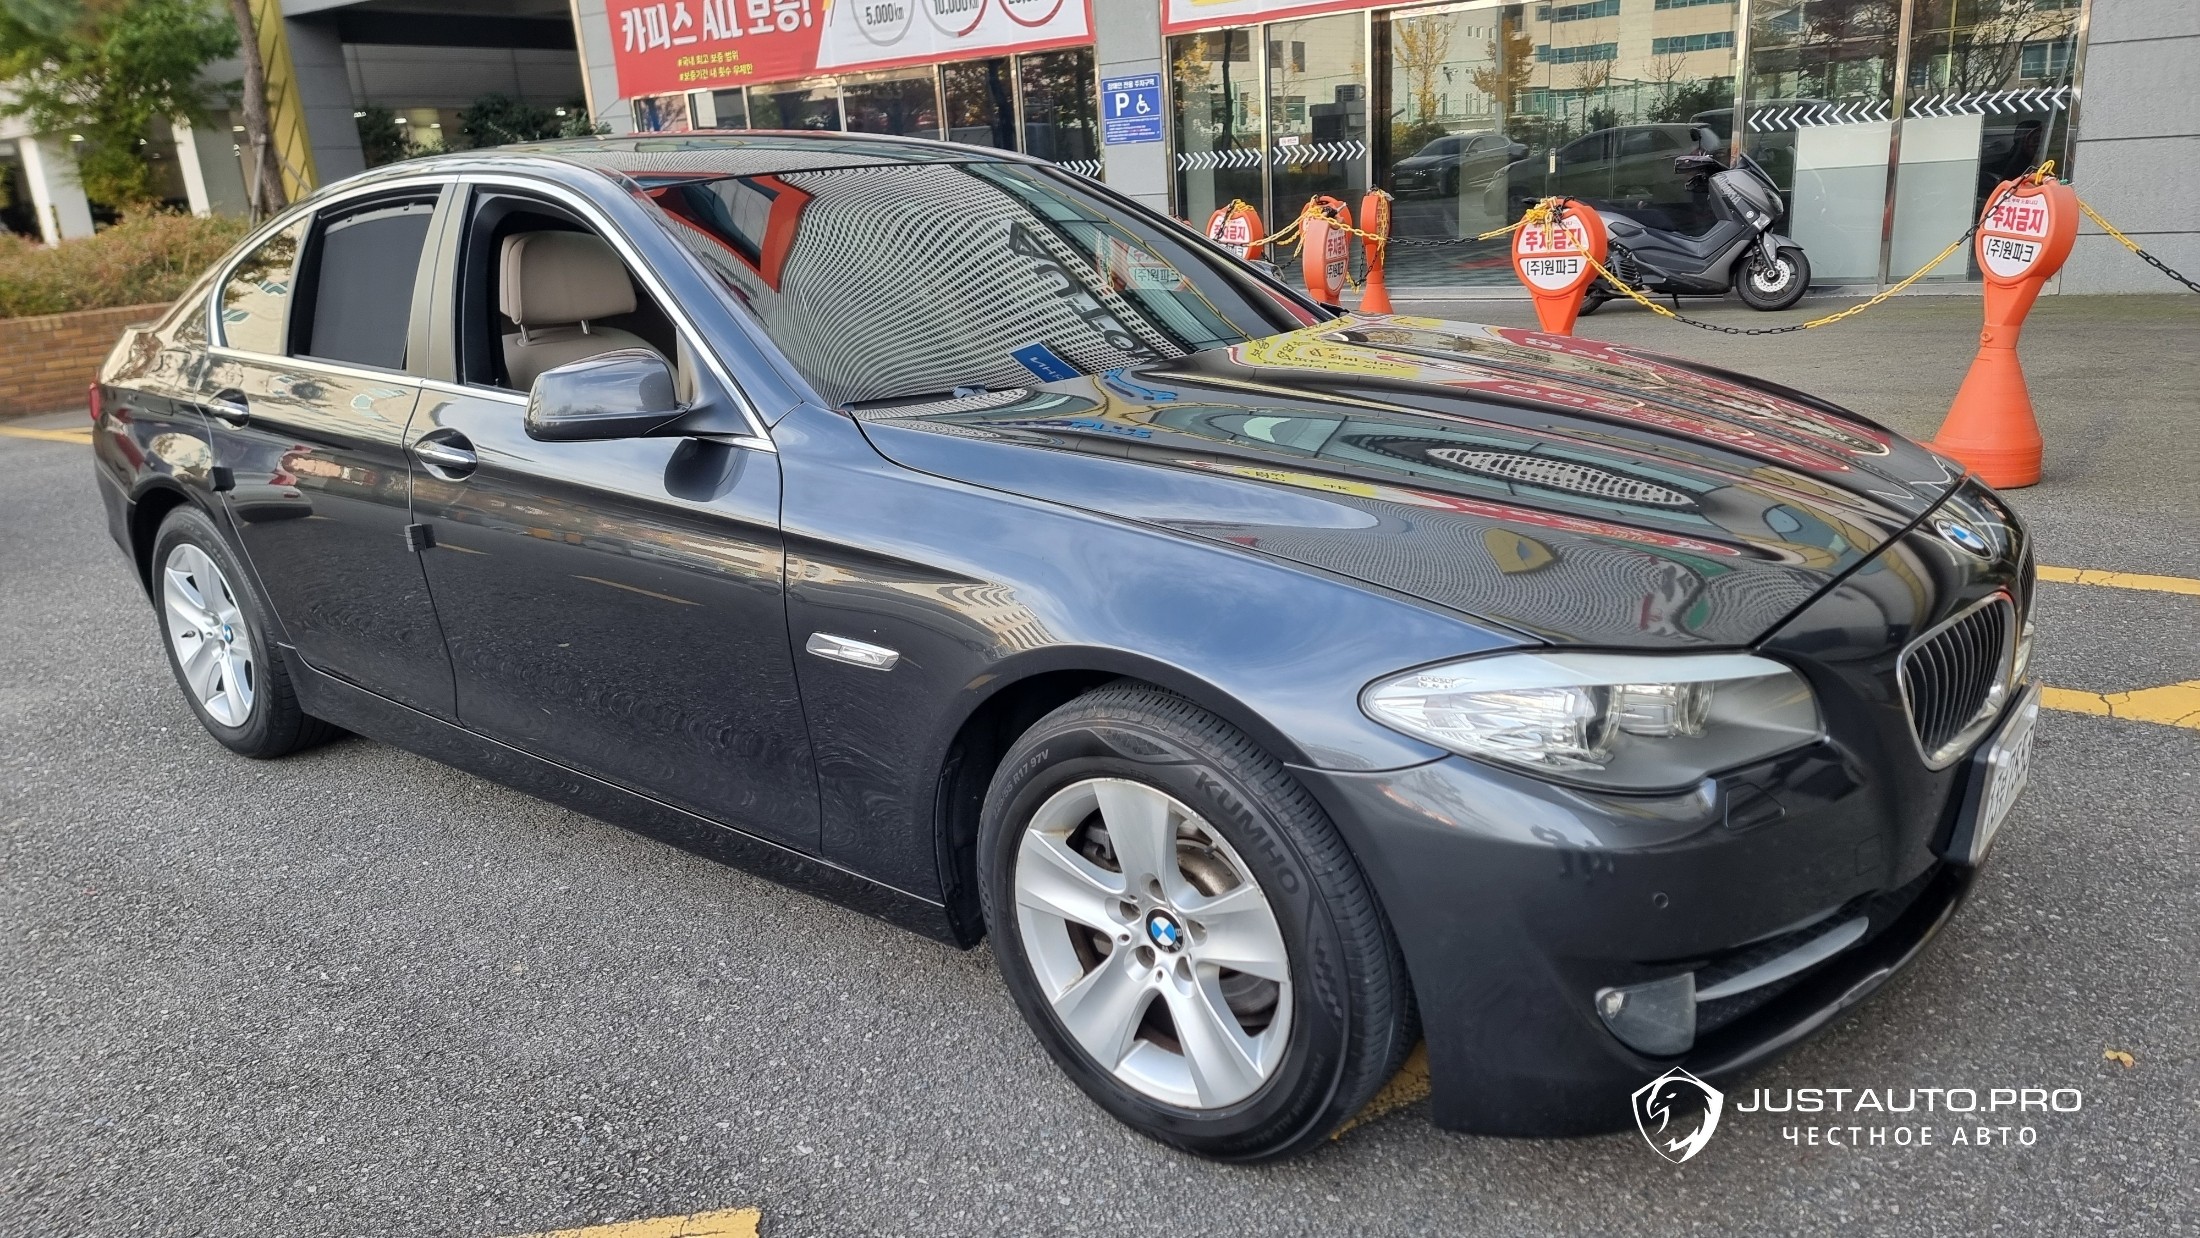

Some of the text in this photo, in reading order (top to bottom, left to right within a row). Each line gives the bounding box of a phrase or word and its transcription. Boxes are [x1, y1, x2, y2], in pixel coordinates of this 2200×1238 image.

[620, 1, 698, 54] 카피스
[703, 0, 744, 41] ALL
[1115, 92, 1129, 117] P
[1992, 205, 2045, 234] 주차금지
[1030, 748, 1049, 768] 97V
[1195, 771, 1300, 895] KUMHO
